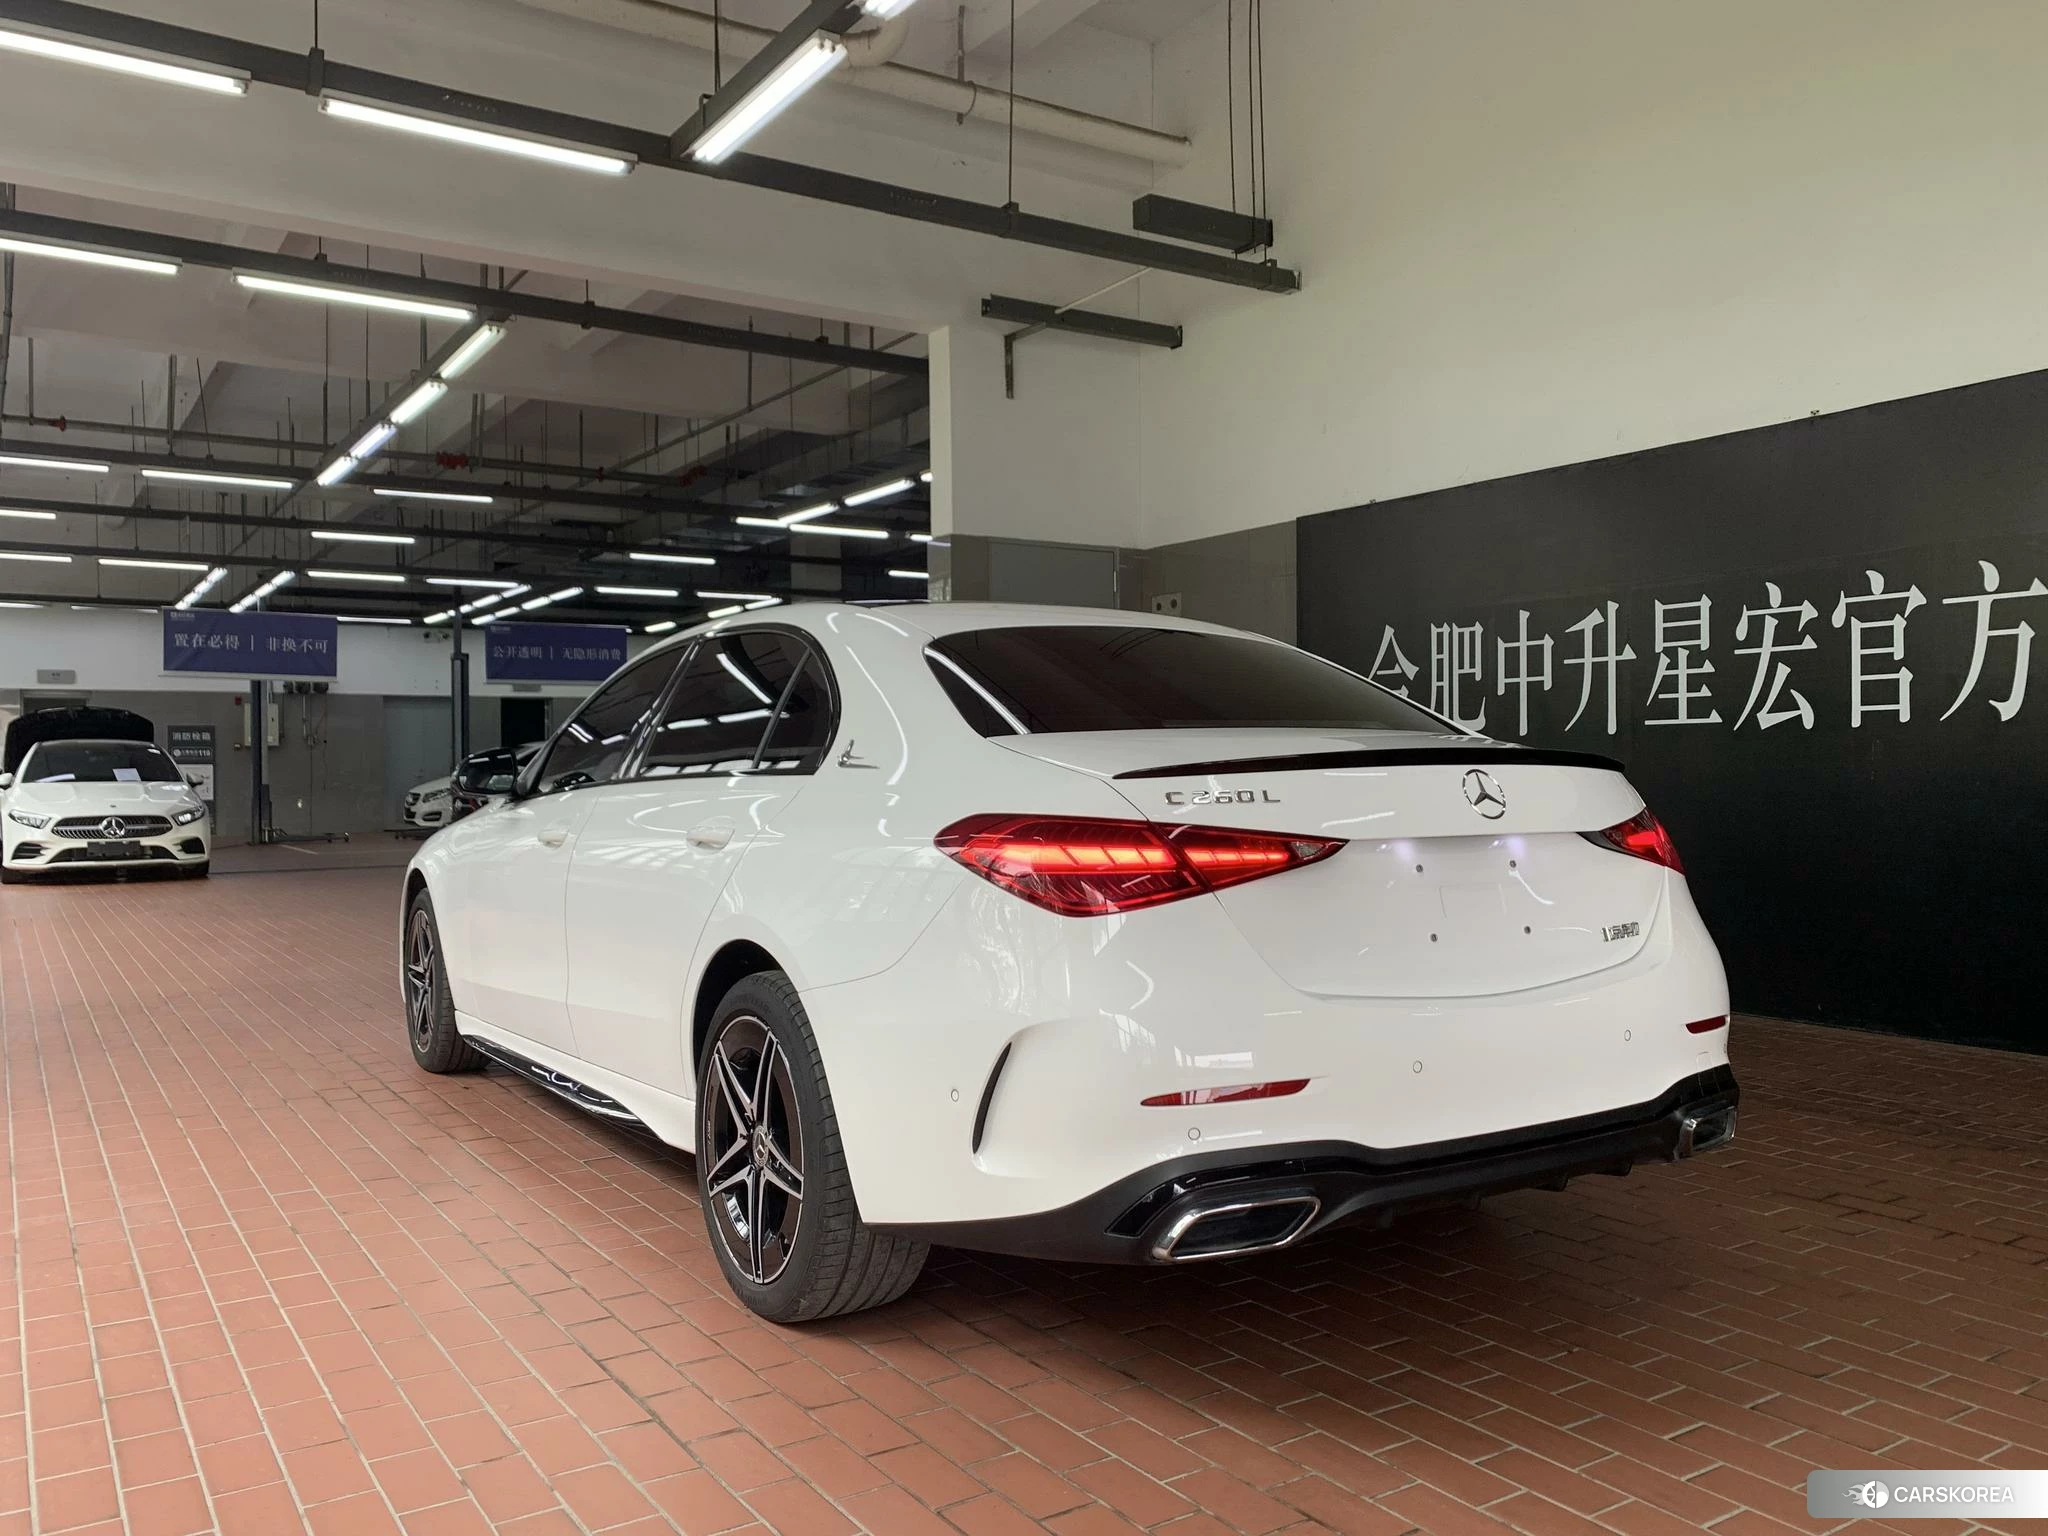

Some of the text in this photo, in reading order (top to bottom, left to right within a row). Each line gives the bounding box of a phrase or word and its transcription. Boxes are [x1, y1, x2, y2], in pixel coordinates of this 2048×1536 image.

[174, 632, 328, 653] 置在必得 非换不可
[494, 645, 622, 661] 公开透明 无隐形消费
[1165, 789, 1281, 806] C 260 L
